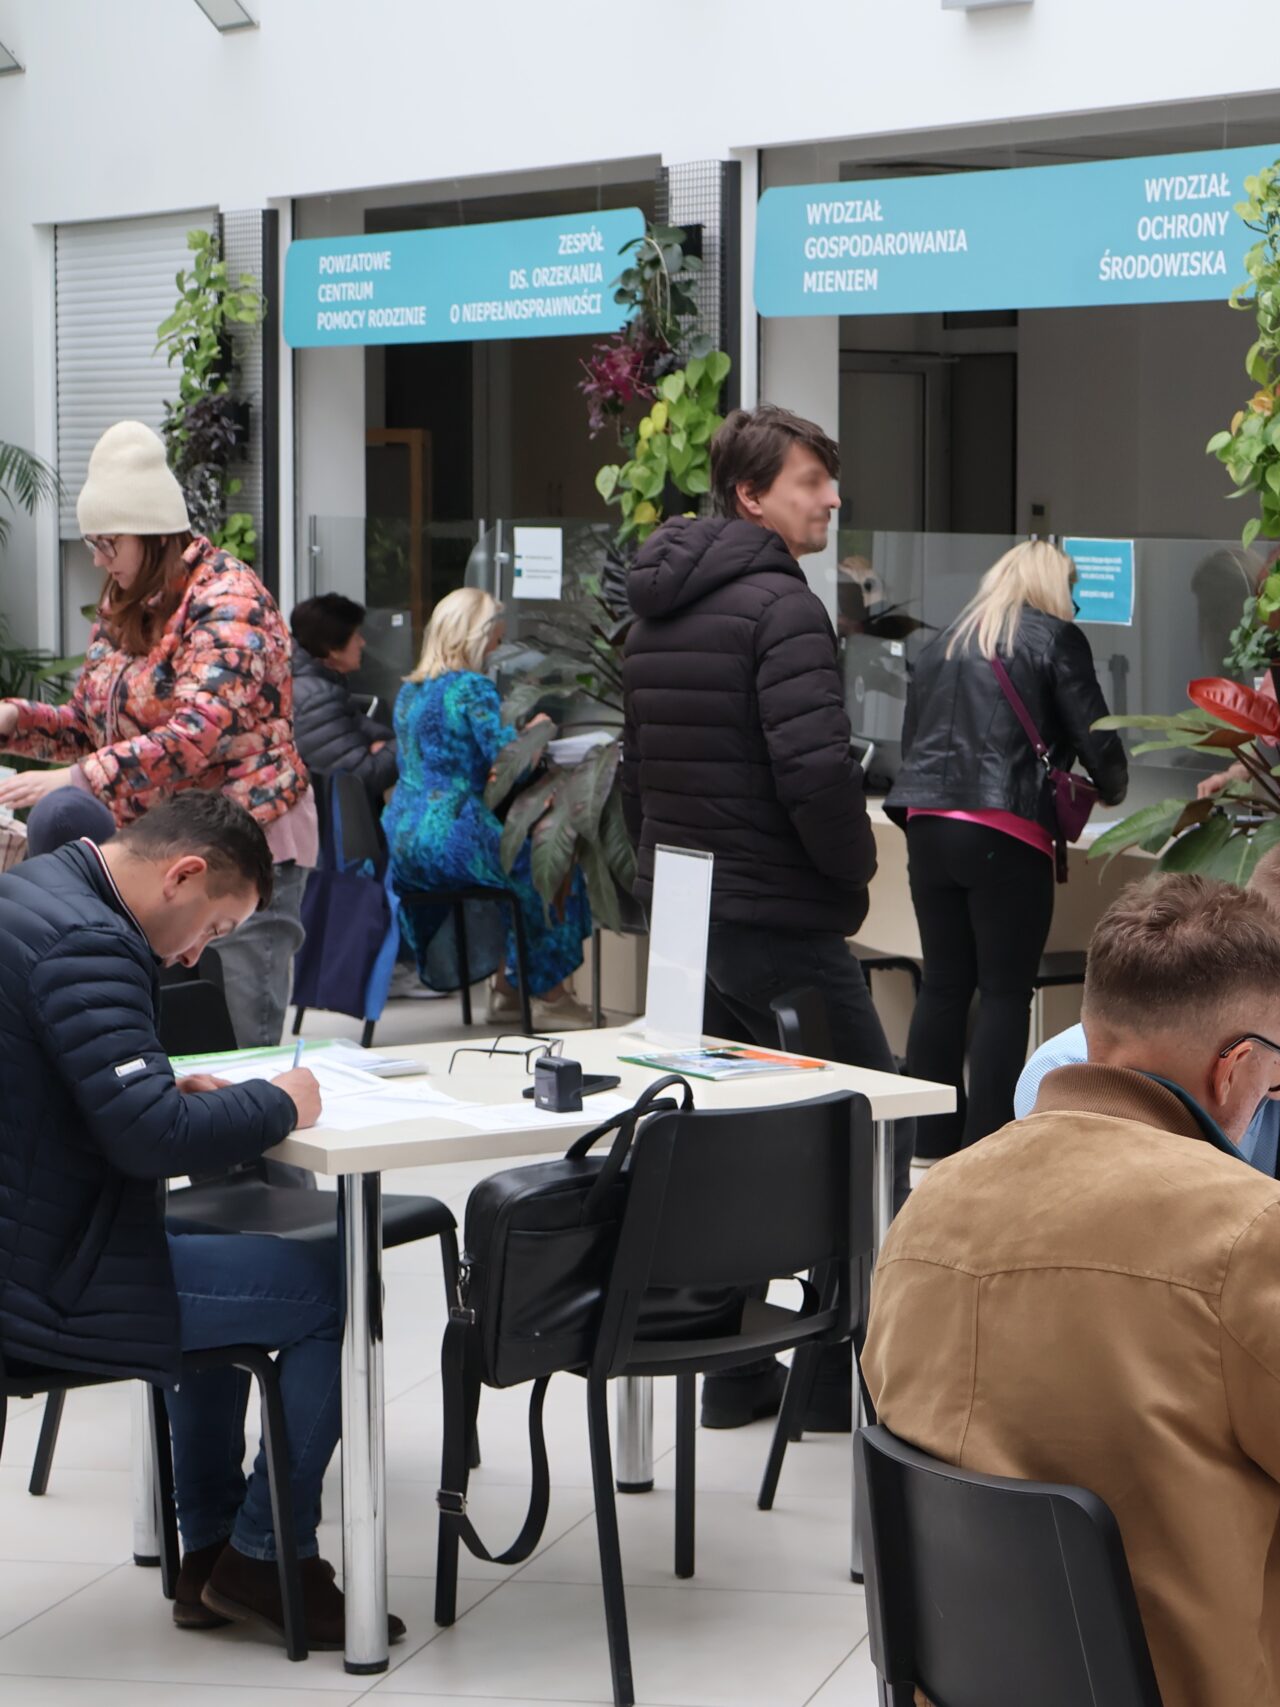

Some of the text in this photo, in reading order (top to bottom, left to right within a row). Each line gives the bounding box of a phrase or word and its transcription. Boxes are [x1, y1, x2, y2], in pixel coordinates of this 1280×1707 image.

[1145, 173, 1231, 203] WYDZIAŁ
[806, 199, 884, 225] WYDZIAŁ
[1137, 211, 1230, 241] OCHRONY
[558, 225, 605, 255] ZESPÓŁ
[804, 229, 967, 260] GOSPODAROWANIA
[319, 250, 392, 275] POWIATOWE
[509, 263, 604, 290] DS. ORZEKANIA
[1098, 249, 1227, 281] ŚRODOWISKA
[318, 281, 374, 303] CENTRUM
[803, 268, 878, 293] MIENIEM
[316, 306, 427, 331] POMOCY RODZINIE
[450, 289, 602, 324] O NIEPEŁNOSPRAWNOŚCI
